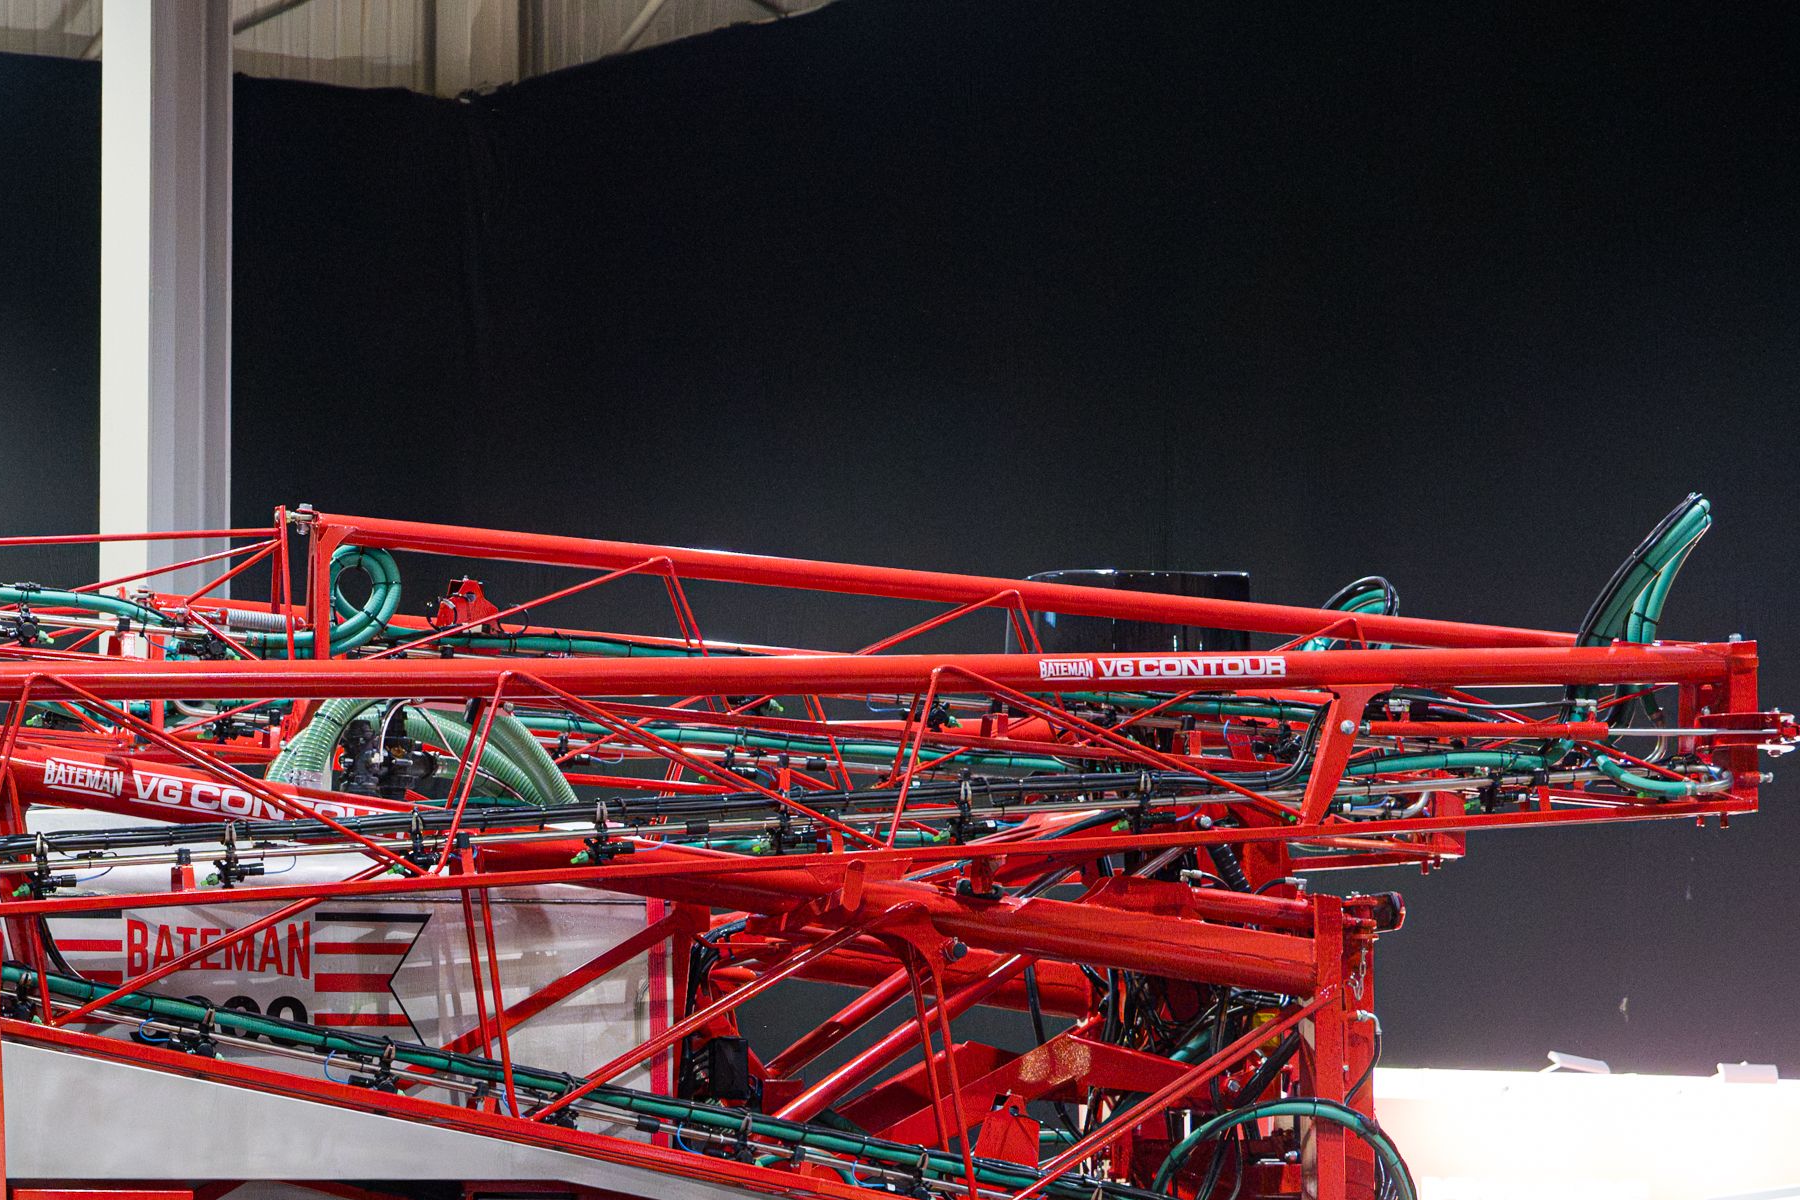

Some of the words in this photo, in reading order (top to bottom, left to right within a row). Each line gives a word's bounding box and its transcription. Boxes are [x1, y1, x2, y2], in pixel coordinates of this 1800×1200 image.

[1038, 659, 1094, 680] BATEMAN
[1098, 658, 1135, 677] VG
[1138, 656, 1287, 677] CONTOUR
[43, 759, 124, 797] BATEMAN
[131, 772, 185, 805] VG
[126, 918, 311, 980] BATEMAN
